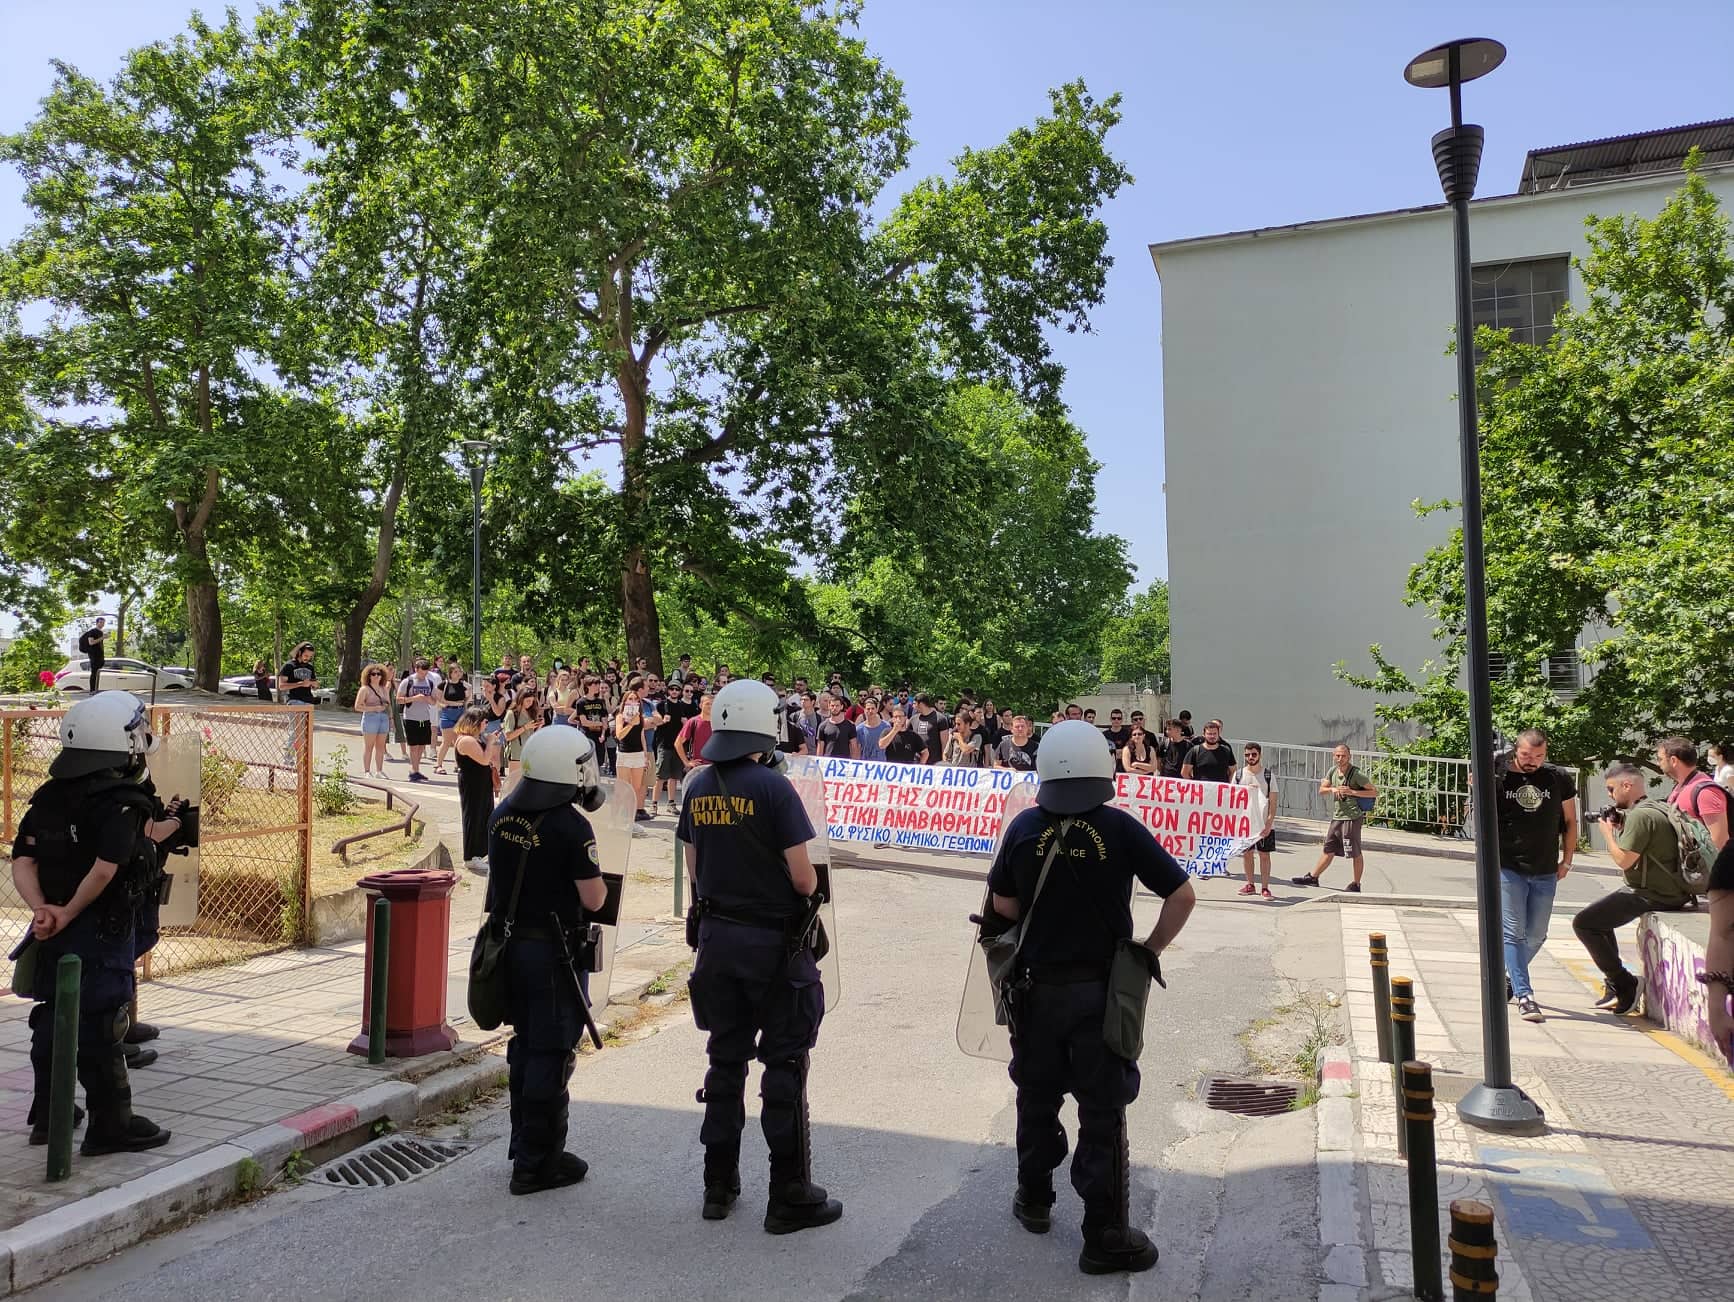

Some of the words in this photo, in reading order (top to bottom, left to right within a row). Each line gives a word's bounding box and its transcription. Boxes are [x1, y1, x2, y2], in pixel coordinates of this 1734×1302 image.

[825, 759, 934, 786] ΑΣΤΥΝΟΜΙΑ
[941, 768, 979, 787] ΑΠΟ
[990, 770, 1013, 790] ΤΟ
[1135, 776, 1204, 805] ΣΚΕΨΗ
[1217, 784, 1249, 811] ΓΙΑ
[883, 808, 1003, 838] ΑΝΑΒΑΘΜΙΣΗ
[887, 785, 923, 808] ΤΗΣ
[926, 789, 979, 812] ΟΠΠΙ!
[1139, 805, 1179, 832] ΤΟΝ
[1187, 810, 1250, 838] ΑΓΩΝΑ
